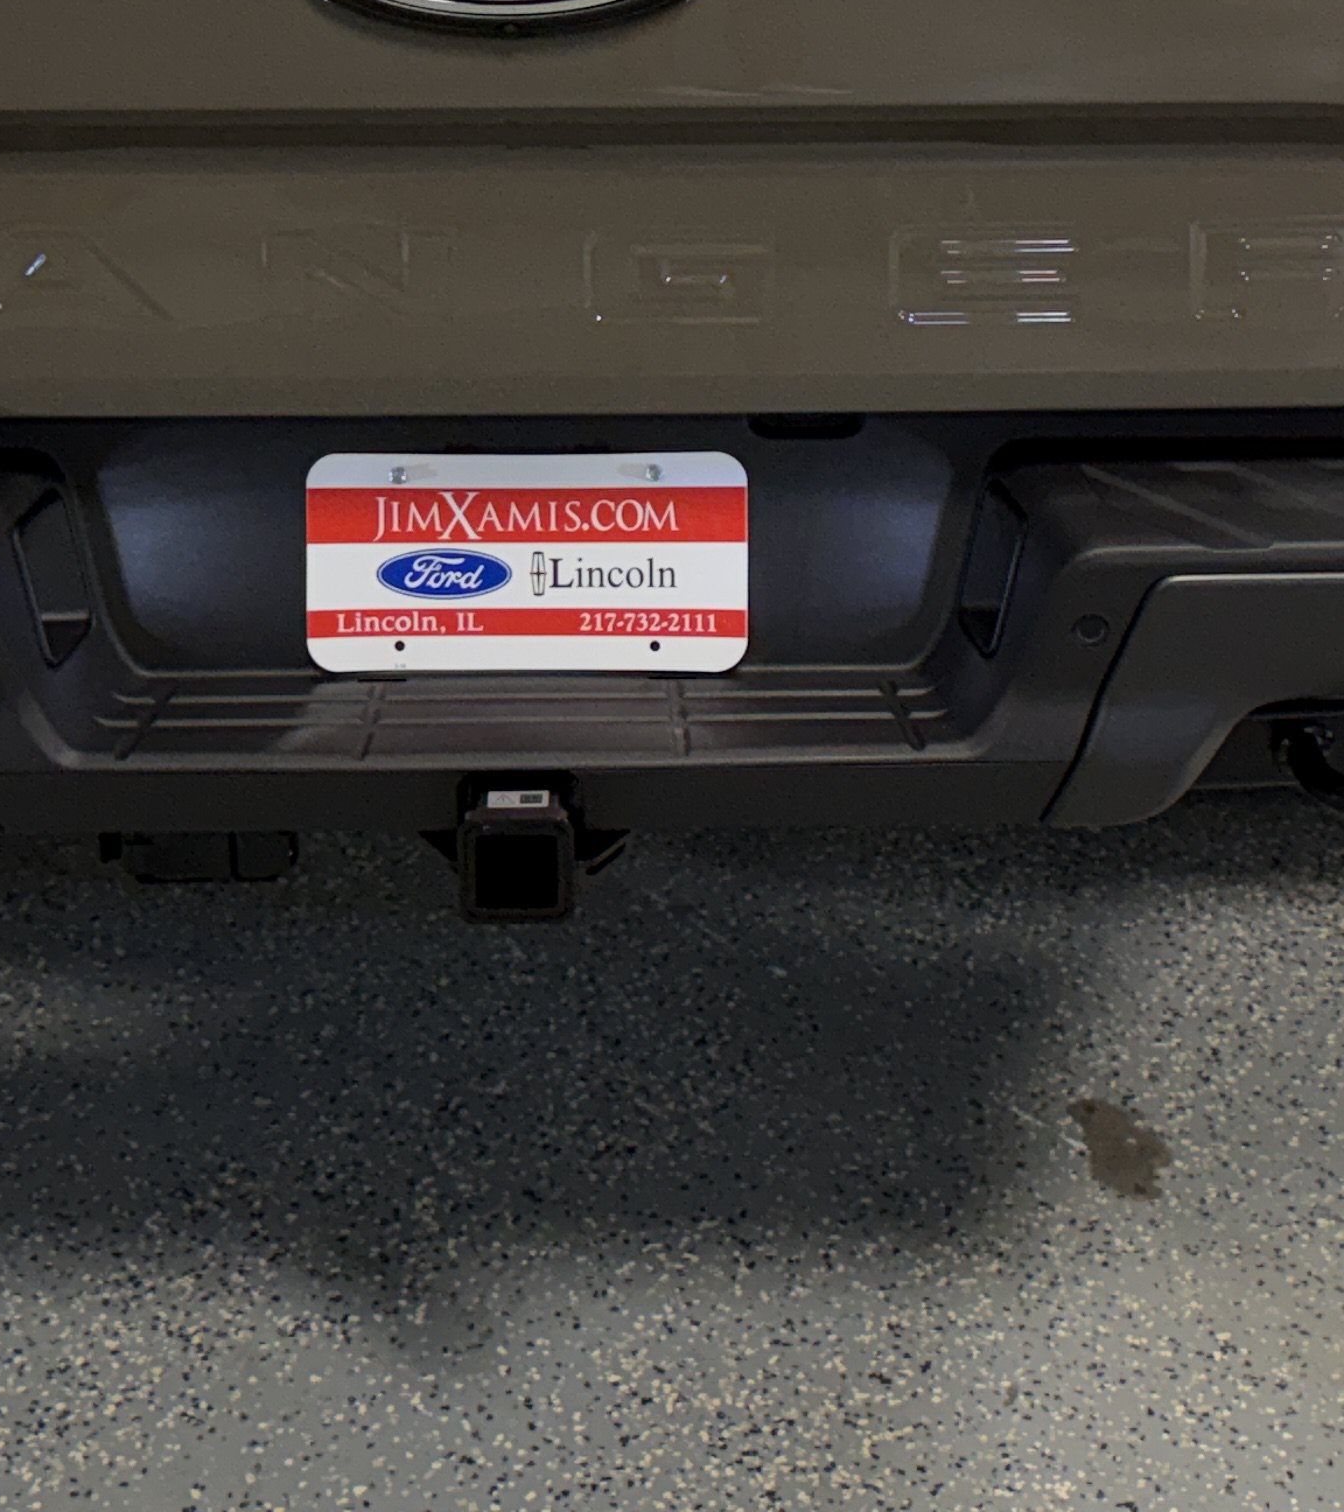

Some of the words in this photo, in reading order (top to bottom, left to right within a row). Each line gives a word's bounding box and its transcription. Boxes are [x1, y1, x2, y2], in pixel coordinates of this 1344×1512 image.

[403, 554, 484, 590] Ford
[549, 557, 678, 589] Lincoln
[336, 611, 447, 635] Lincoln,
[457, 613, 484, 632] IL
[579, 613, 717, 633] 217-732-2111
